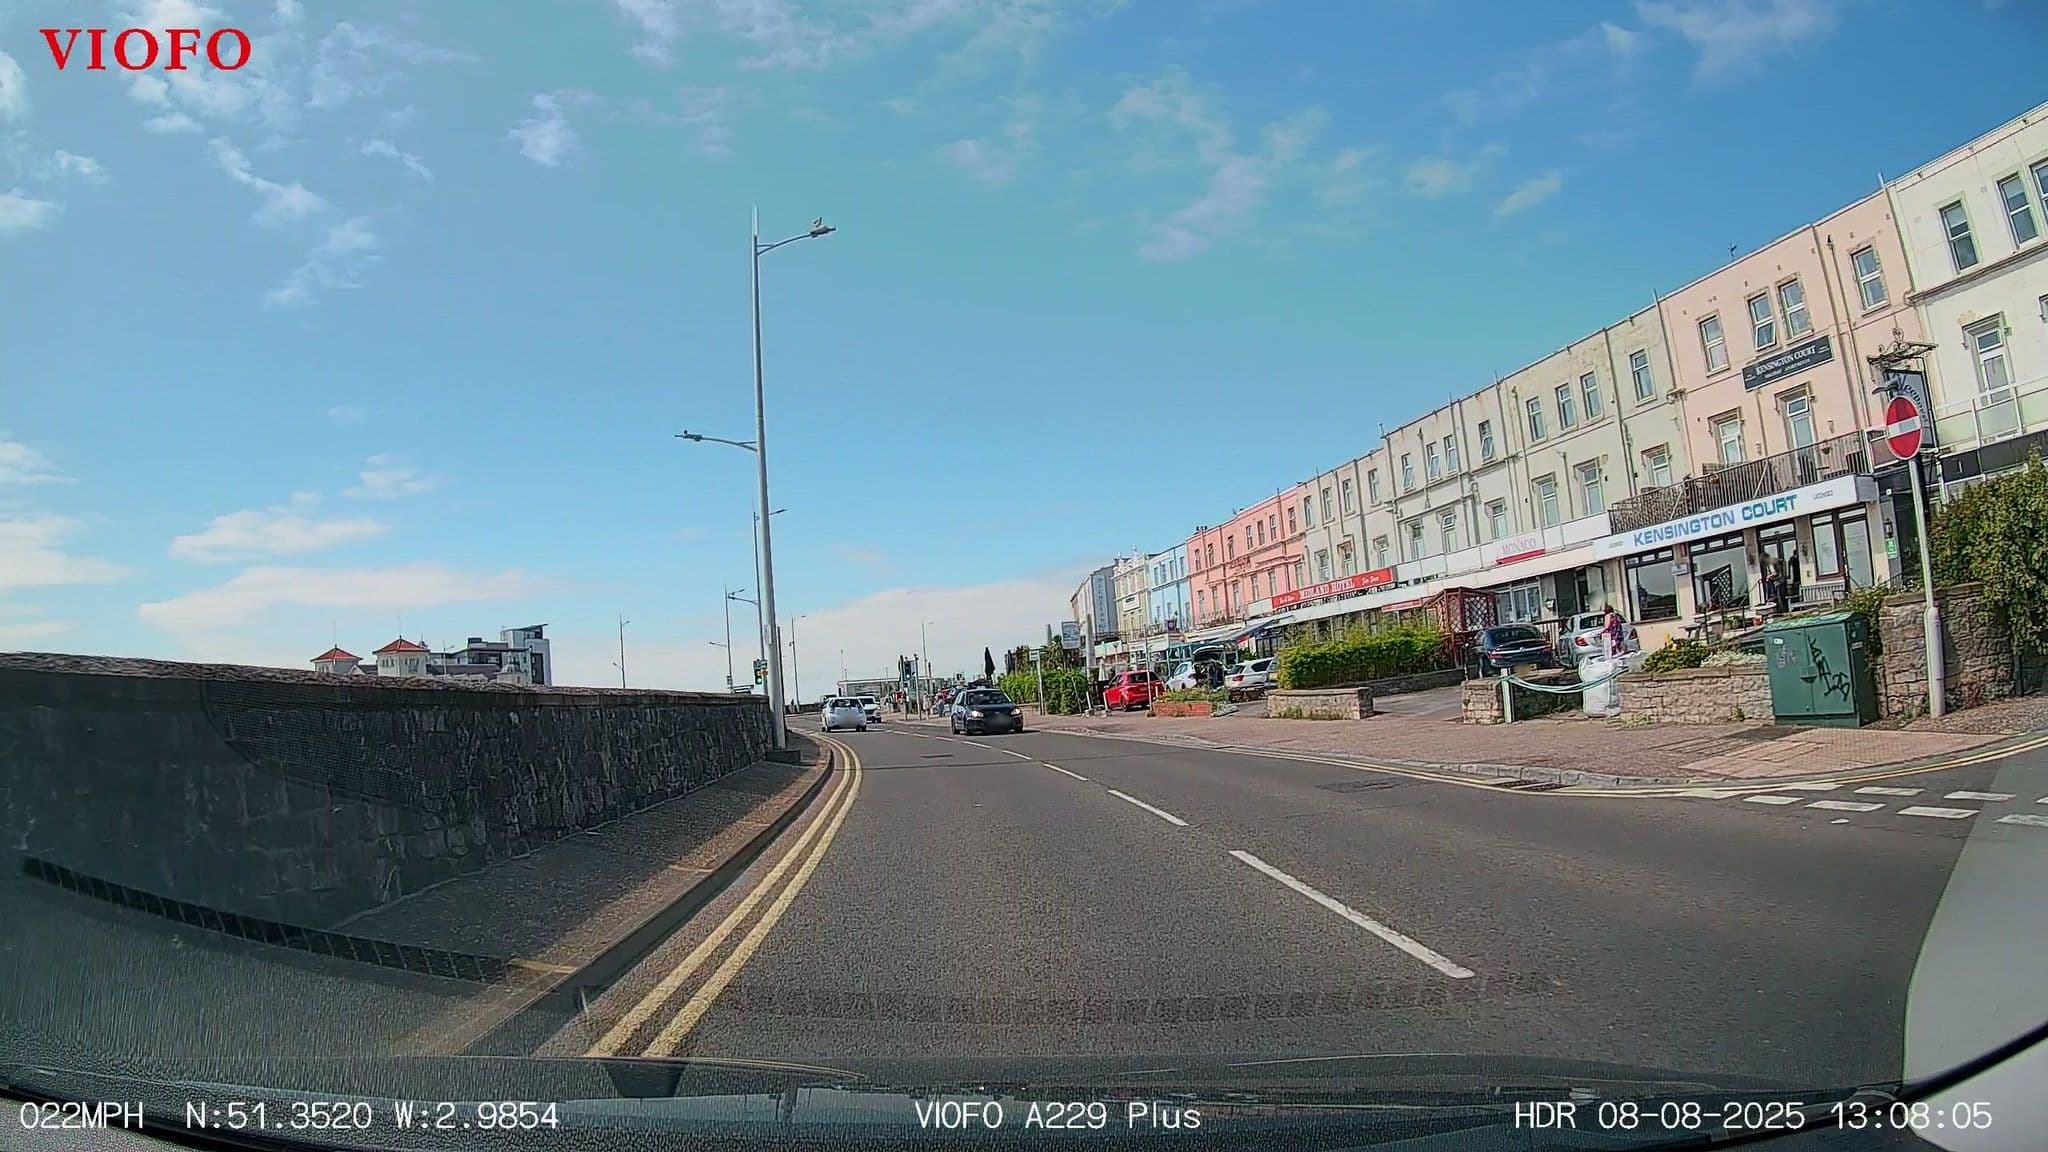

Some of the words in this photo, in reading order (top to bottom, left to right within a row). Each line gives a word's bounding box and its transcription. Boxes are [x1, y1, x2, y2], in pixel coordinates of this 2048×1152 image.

[1755, 353, 1794, 376] KENSINGTON
[1794, 345, 1816, 360] COURT
[1633, 510, 1736, 548] KENSINGTON
[1741, 494, 1798, 521] COURT
[1331, 578, 1355, 593] HOTEL
